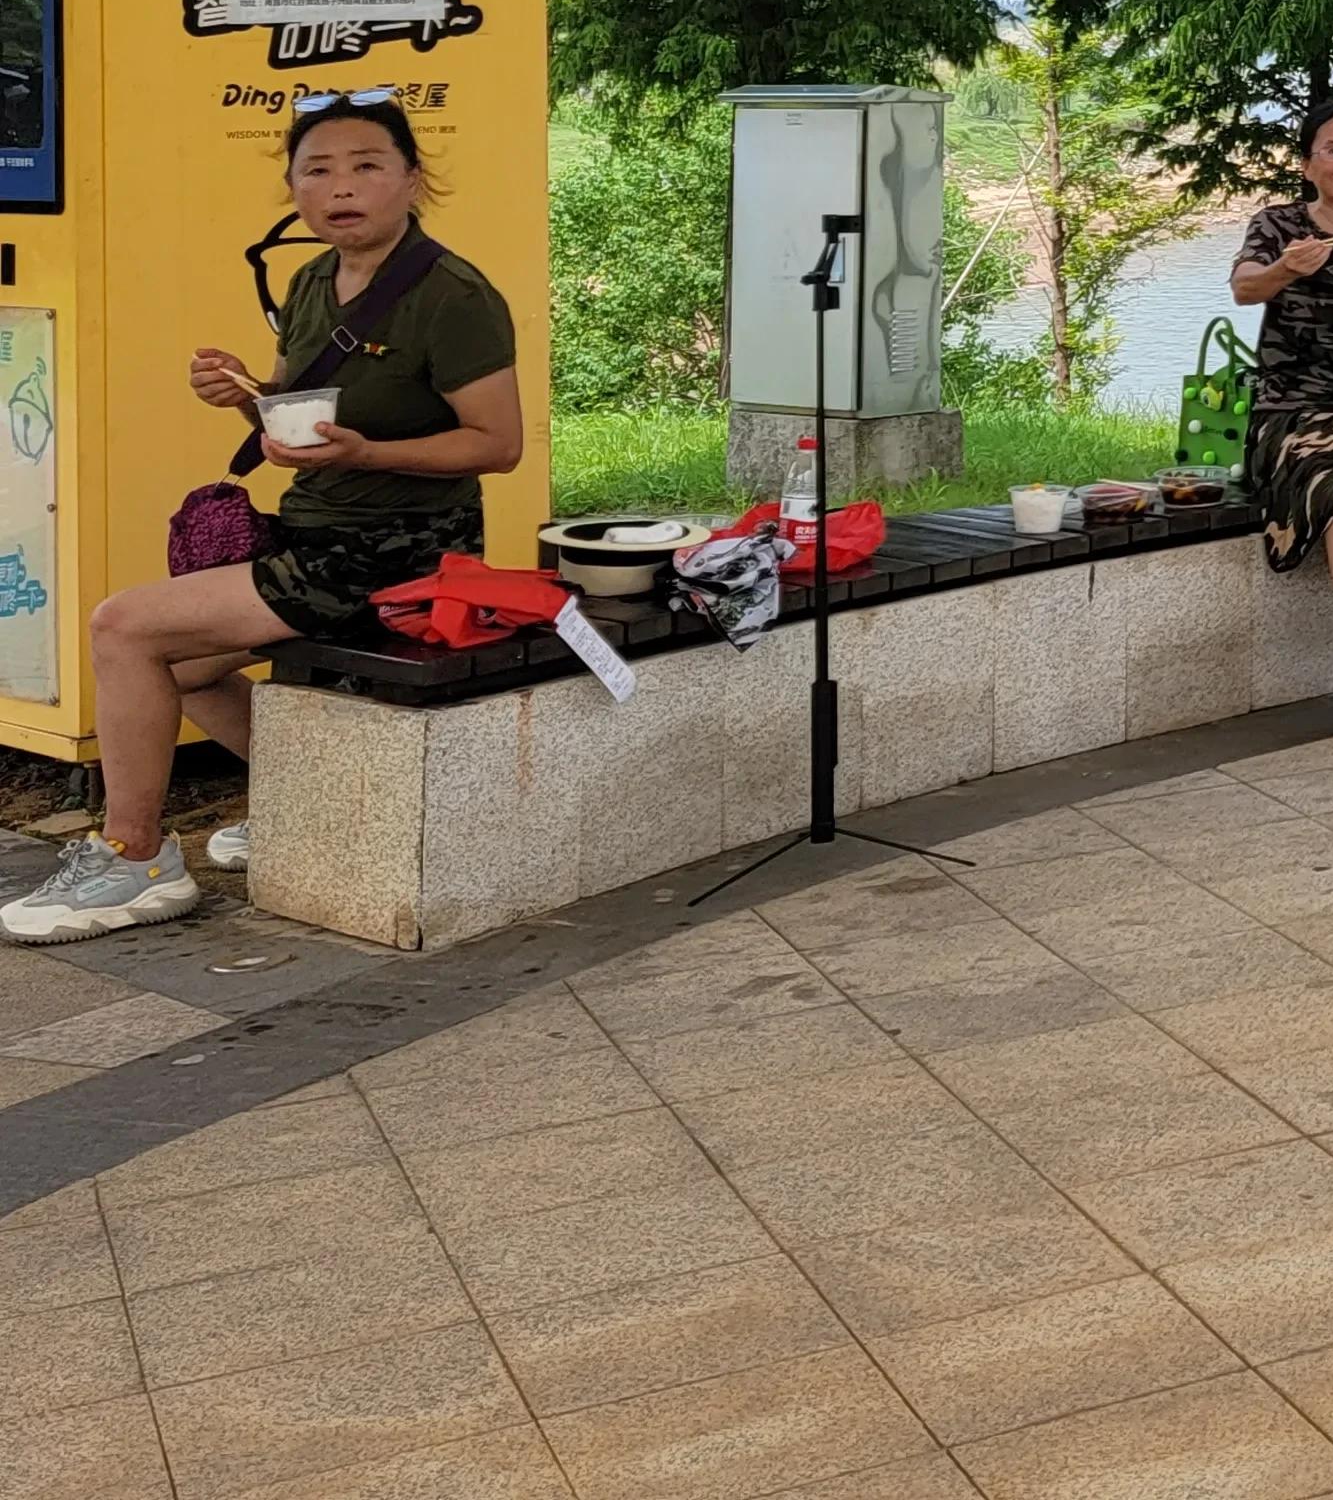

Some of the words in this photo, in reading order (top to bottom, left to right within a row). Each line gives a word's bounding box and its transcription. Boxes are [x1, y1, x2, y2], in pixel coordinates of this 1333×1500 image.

[222, 84, 285, 114] Ding
[376, 83, 449, 108] 咚屋
[226, 130, 270, 139] WISDOM
